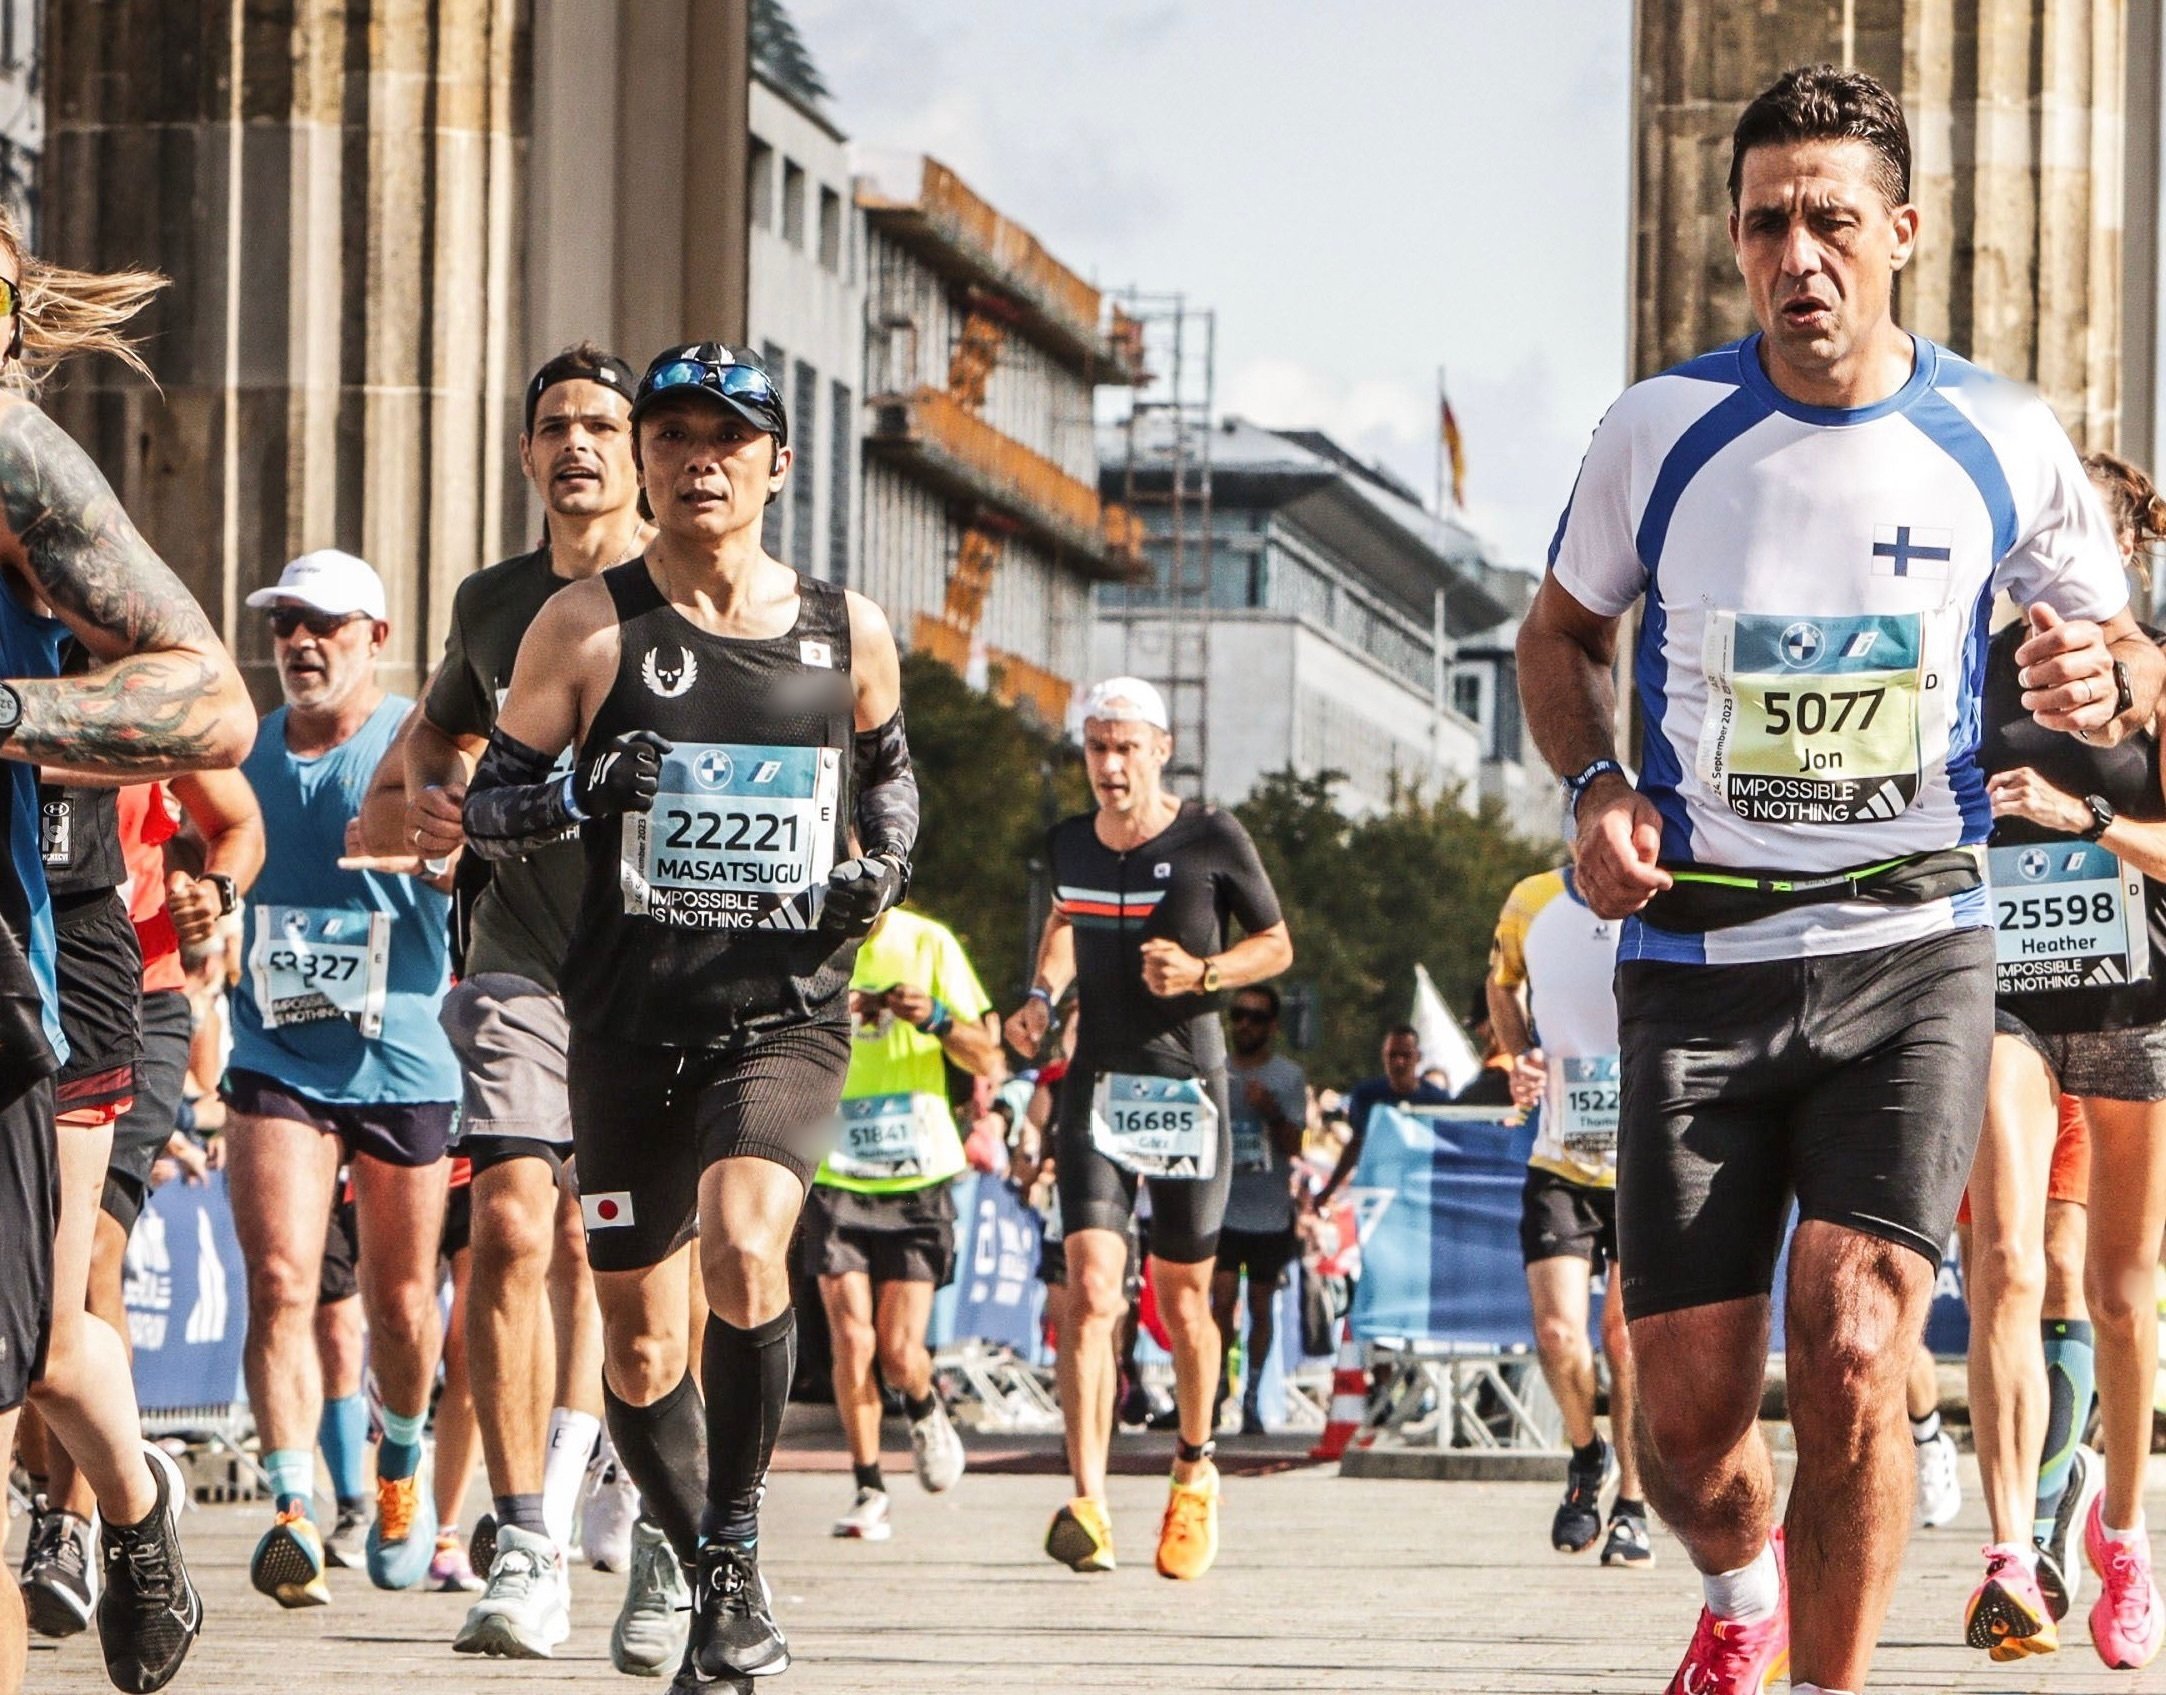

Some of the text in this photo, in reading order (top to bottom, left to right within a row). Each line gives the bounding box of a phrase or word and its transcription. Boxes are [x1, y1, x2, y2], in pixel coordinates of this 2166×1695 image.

[1924, 673, 1938, 690] D
[1764, 687, 1886, 736] 5077
[1712, 725, 1728, 779] September
[1722, 698, 1733, 724] 2023
[1800, 748, 1843, 773] Jon
[1731, 779, 1855, 801] IMPOSSIBLE
[820, 806, 830, 822] E
[1732, 802, 1850, 823] IS NOTHING
[637, 818, 647, 840] 2023
[665, 809, 799, 853] 22221
[656, 858, 803, 884] MASATSUGU
[651, 888, 760, 912] IMPOSSIBLE
[2129, 884, 2139, 896] D
[651, 906, 754, 930] IS NOTHING
[1998, 892, 2115, 931] 25598
[2021, 935, 2097, 954] Heather
[1997, 958, 2083, 978] IMPOSSIBLE
[1998, 974, 2081, 993] IS NOTHING
[1115, 1110, 1193, 1132] 16685
